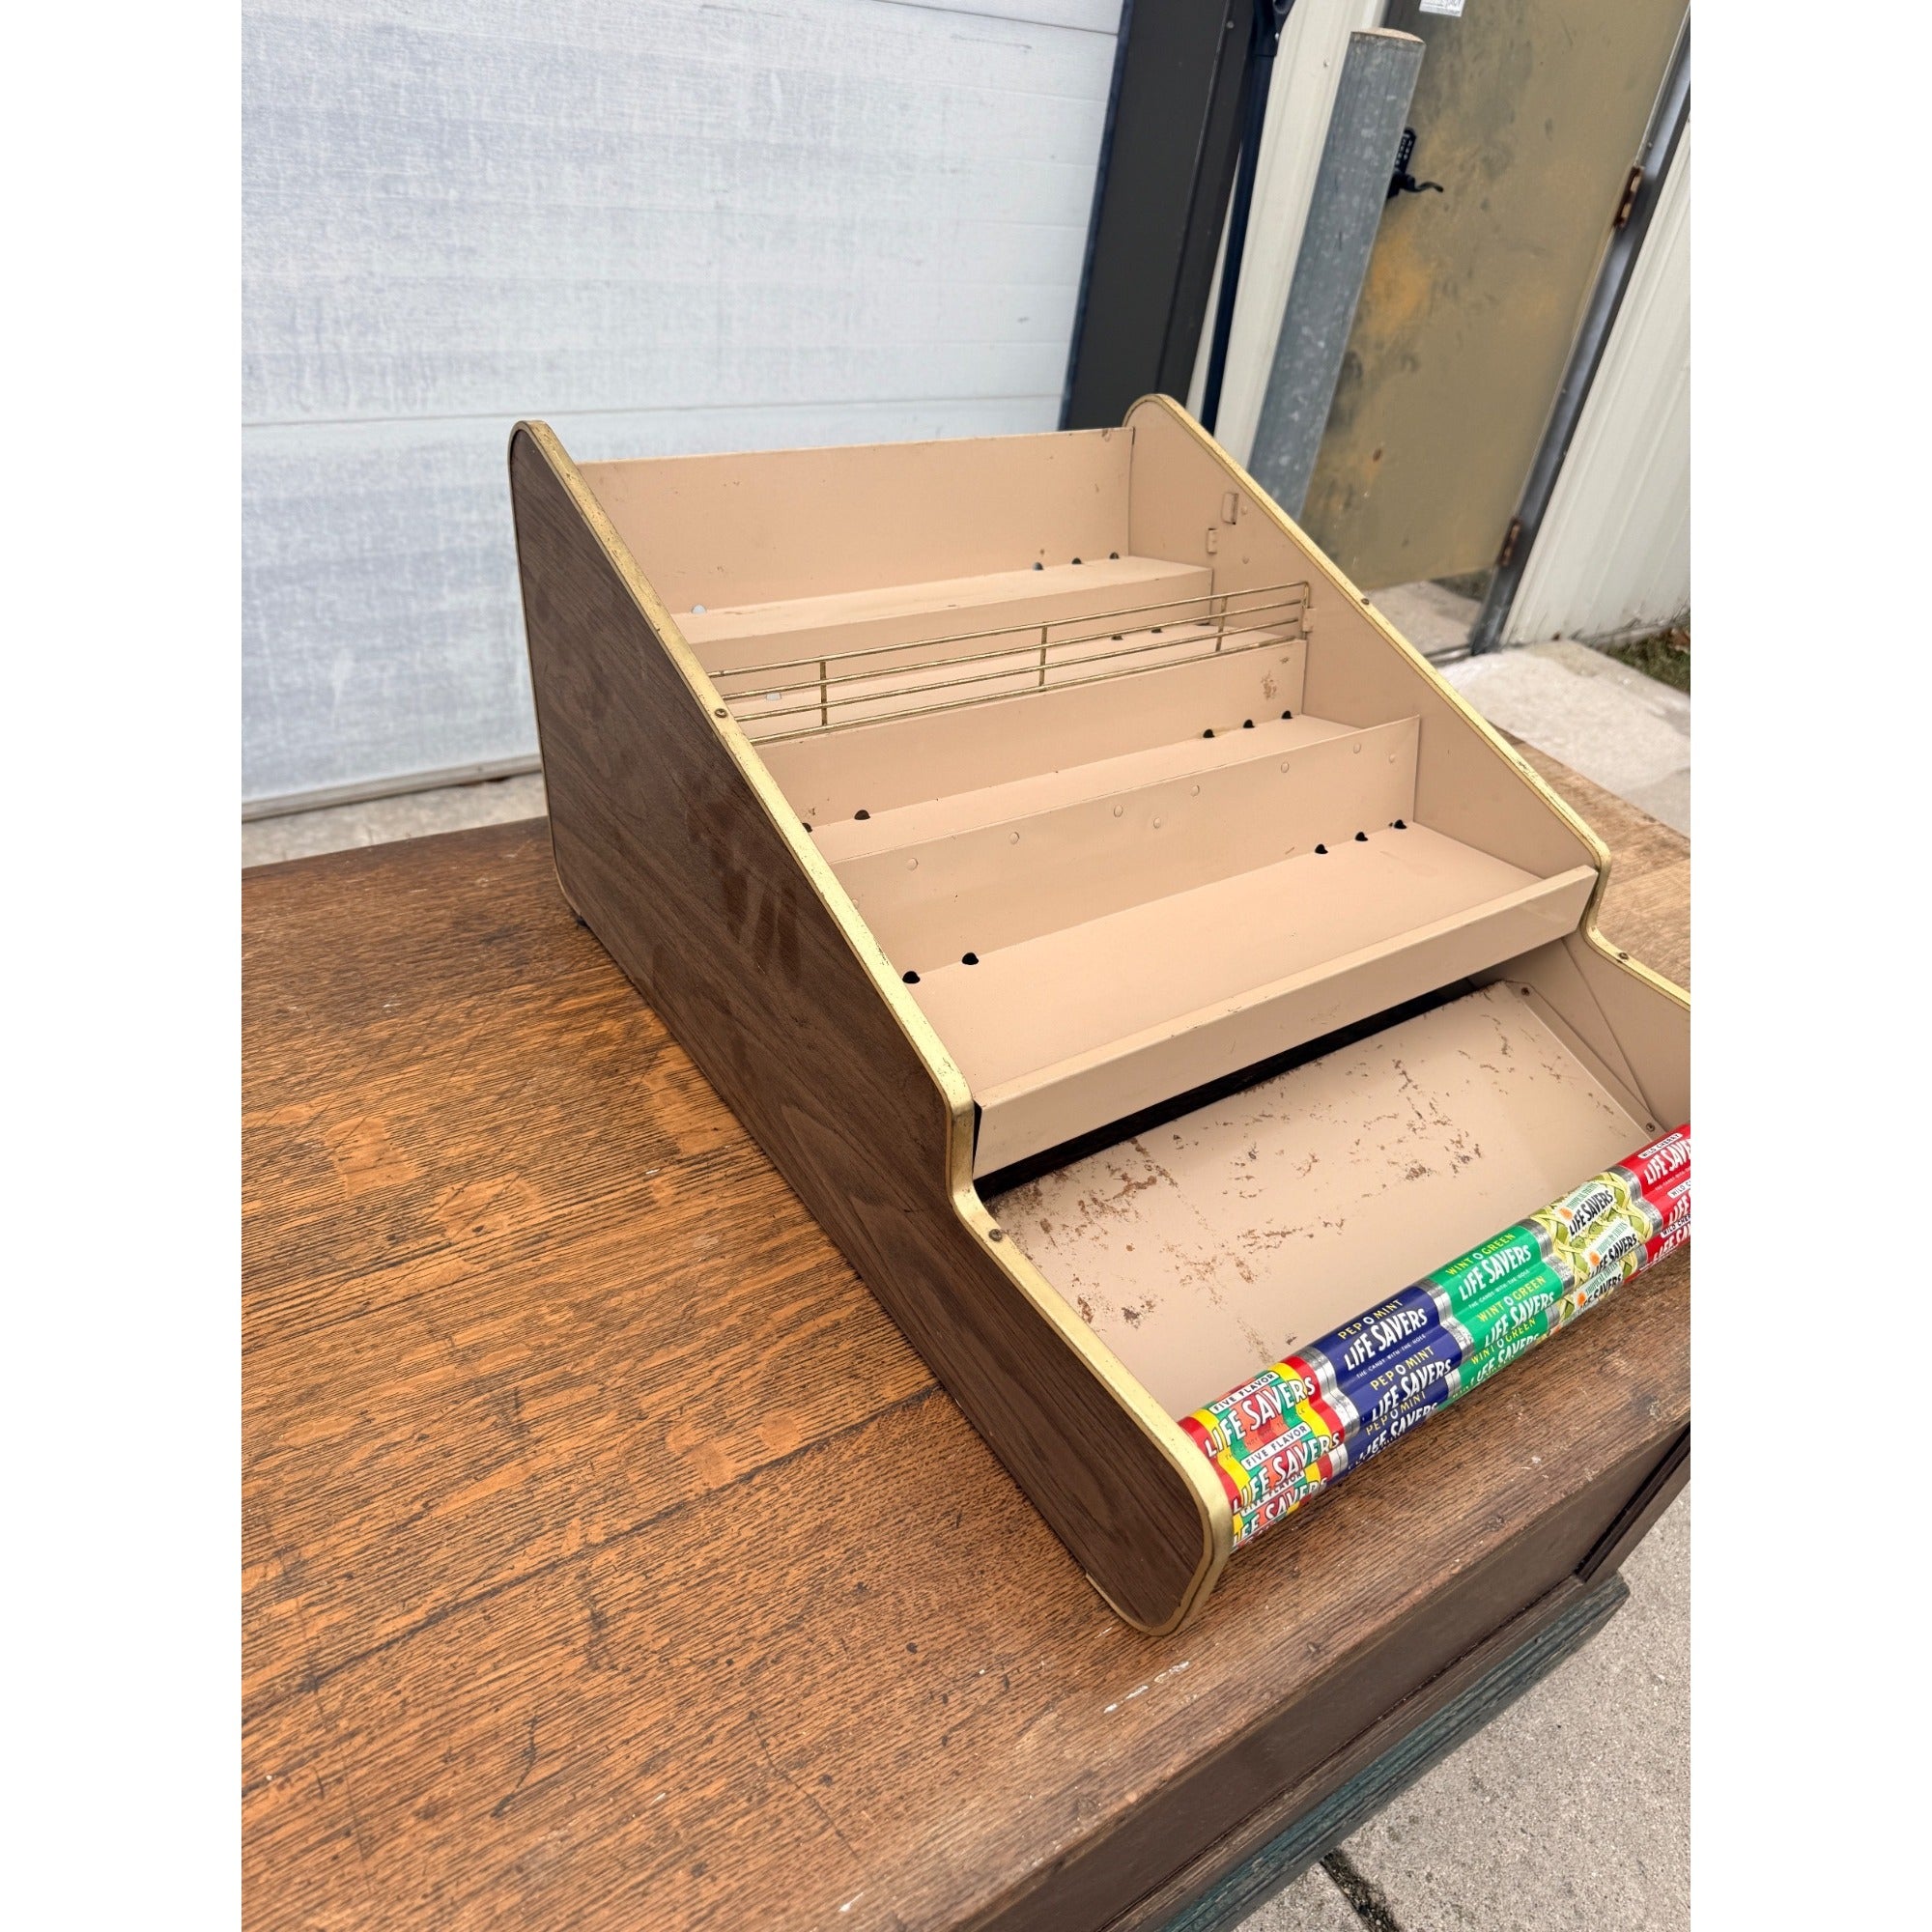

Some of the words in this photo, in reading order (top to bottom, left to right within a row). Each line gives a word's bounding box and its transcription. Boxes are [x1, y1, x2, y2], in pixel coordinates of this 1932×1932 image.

[1644, 1154, 1668, 1185] LIFE
[1671, 1184, 1686, 1197] WILD
[1570, 1209, 1586, 1236] LIFE
[1580, 1190, 1614, 1222] SAVERS
[1662, 1223, 1676, 1236] WILD
[1669, 1195, 1690, 1226] LIFE
[1445, 1257, 1474, 1275] WINT
[1481, 1233, 1516, 1255] GREEN
[1608, 1233, 1637, 1262] SAVERS
[1458, 1265, 1487, 1301] LIFE
[1481, 1244, 1532, 1284] SAVERS
[1337, 1322, 1362, 1340] PEP
[1362, 1316, 1375, 1324] O
[1373, 1299, 1403, 1320] MINT
[1477, 1300, 1505, 1322] WINT
[1503, 1295, 1514, 1306] O
[1512, 1275, 1546, 1301] GREEN
[1485, 1313, 1509, 1349] LIFE
[1510, 1291, 1554, 1330] SAVERS
[1344, 1332, 1376, 1371] LIFE
[1370, 1308, 1428, 1351] SAVERS
[1370, 1370, 1395, 1390] PEP
[1395, 1364, 1406, 1376] O
[1405, 1345, 1435, 1369] MINT
[1213, 1396, 1236, 1411] FIVE
[1239, 1373, 1275, 1397] FLAVOR
[1372, 1384, 1399, 1422] LIFE
[1401, 1358, 1452, 1402] SAVERS
[1204, 1407, 1247, 1459] LIFE
[1240, 1377, 1317, 1431] SAVERS
[1245, 1450, 1268, 1467] FIVE
[1271, 1425, 1307, 1450] FLAVOR
[1233, 1466, 1270, 1514] LIFE
[1272, 1433, 1340, 1486] SAVERS
